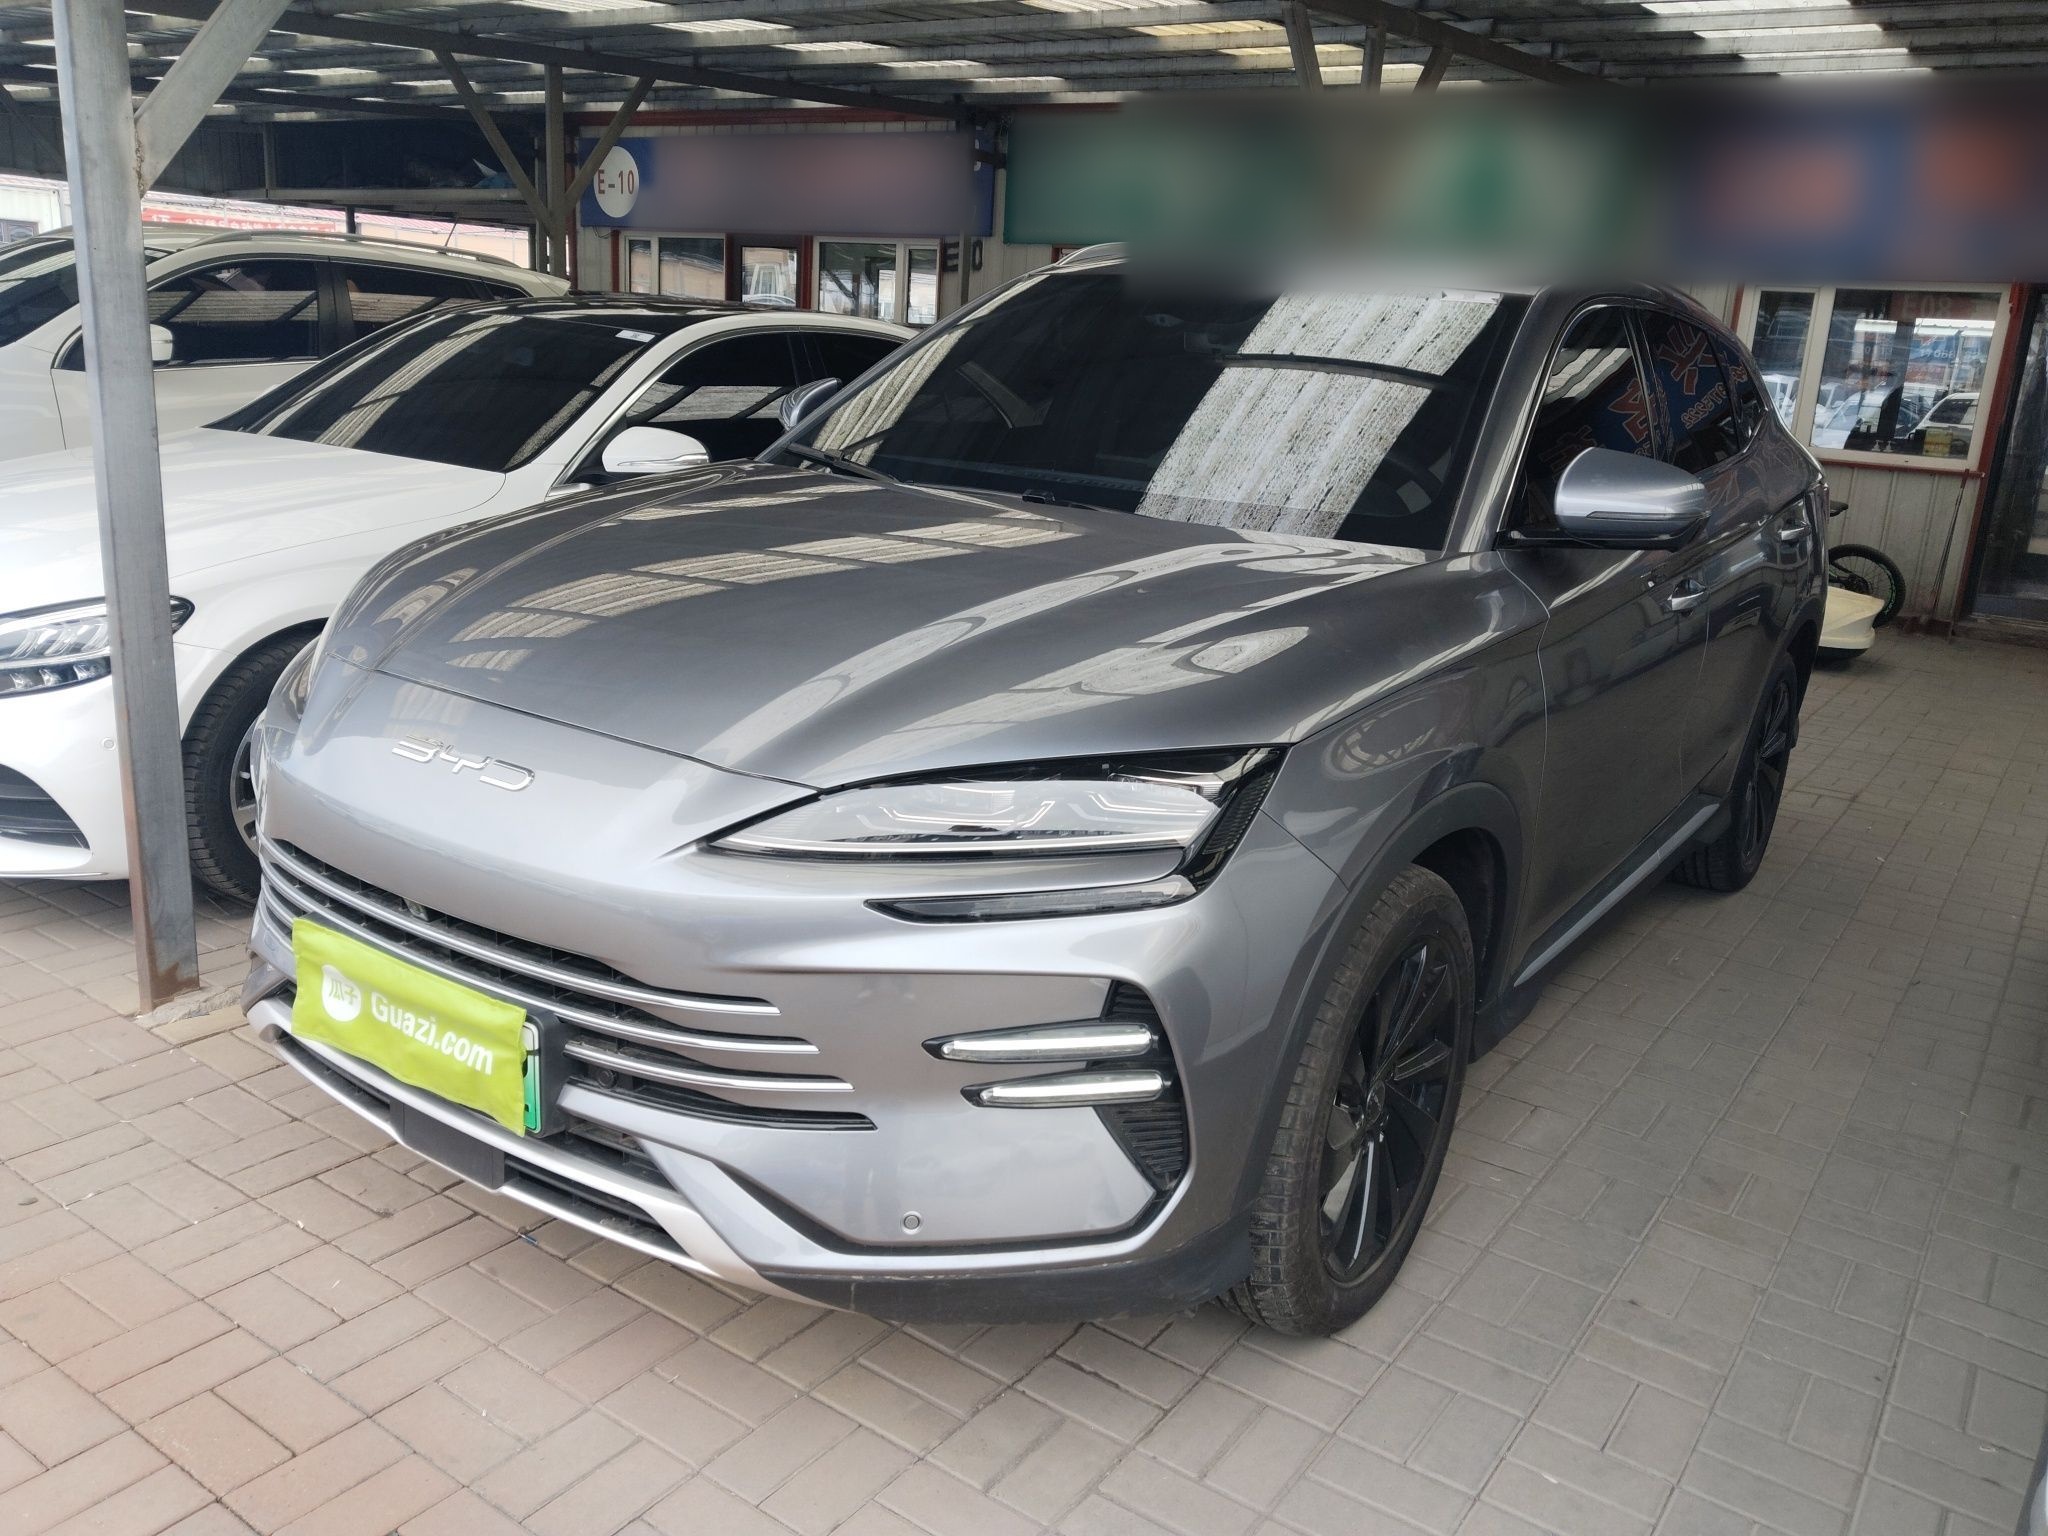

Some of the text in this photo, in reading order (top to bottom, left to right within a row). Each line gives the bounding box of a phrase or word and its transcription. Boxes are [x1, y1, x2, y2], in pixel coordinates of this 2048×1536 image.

[597, 169, 635, 195] E-10
[391, 736, 535, 791] BYD
[371, 992, 493, 1075] Guazi.com
